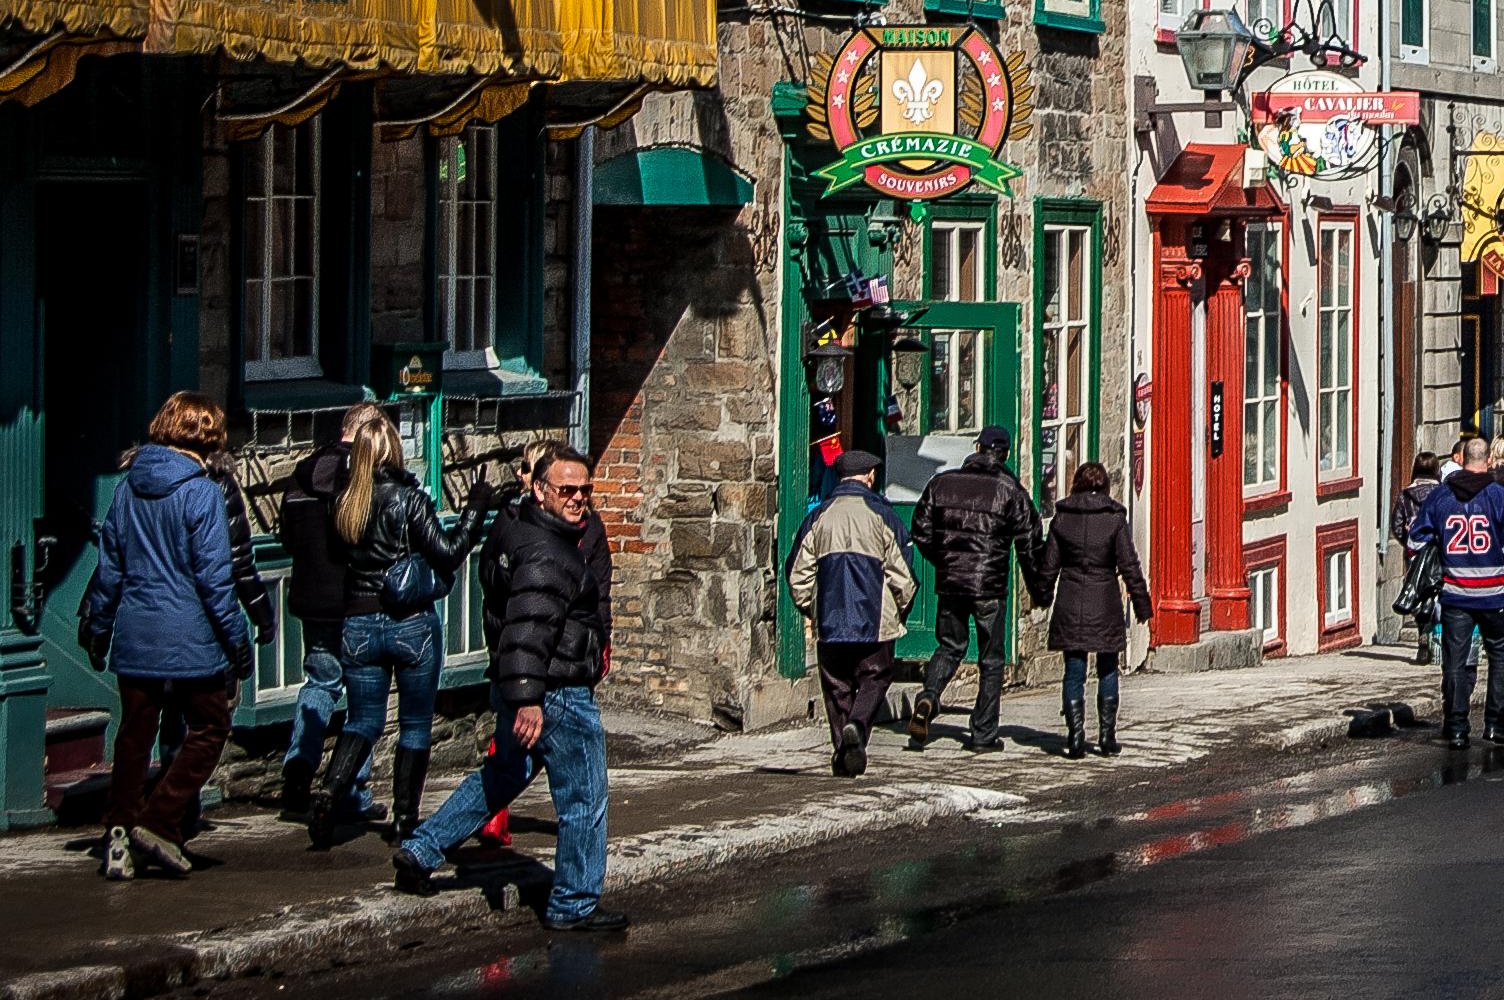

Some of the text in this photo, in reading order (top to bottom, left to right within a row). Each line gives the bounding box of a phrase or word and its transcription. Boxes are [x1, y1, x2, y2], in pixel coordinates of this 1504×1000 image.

[882, 29, 951, 46] MAISON
[1292, 77, 1340, 92] HÔTEL
[1304, 97, 1385, 111] CAVALIER
[861, 136, 973, 159] CRÉMAZIE
[877, 172, 957, 193] SOUVENIRS
[1488, 255, 1501, 271] LA
[1213, 394, 1221, 441] HOTEL
[1445, 515, 1491, 554] 26
